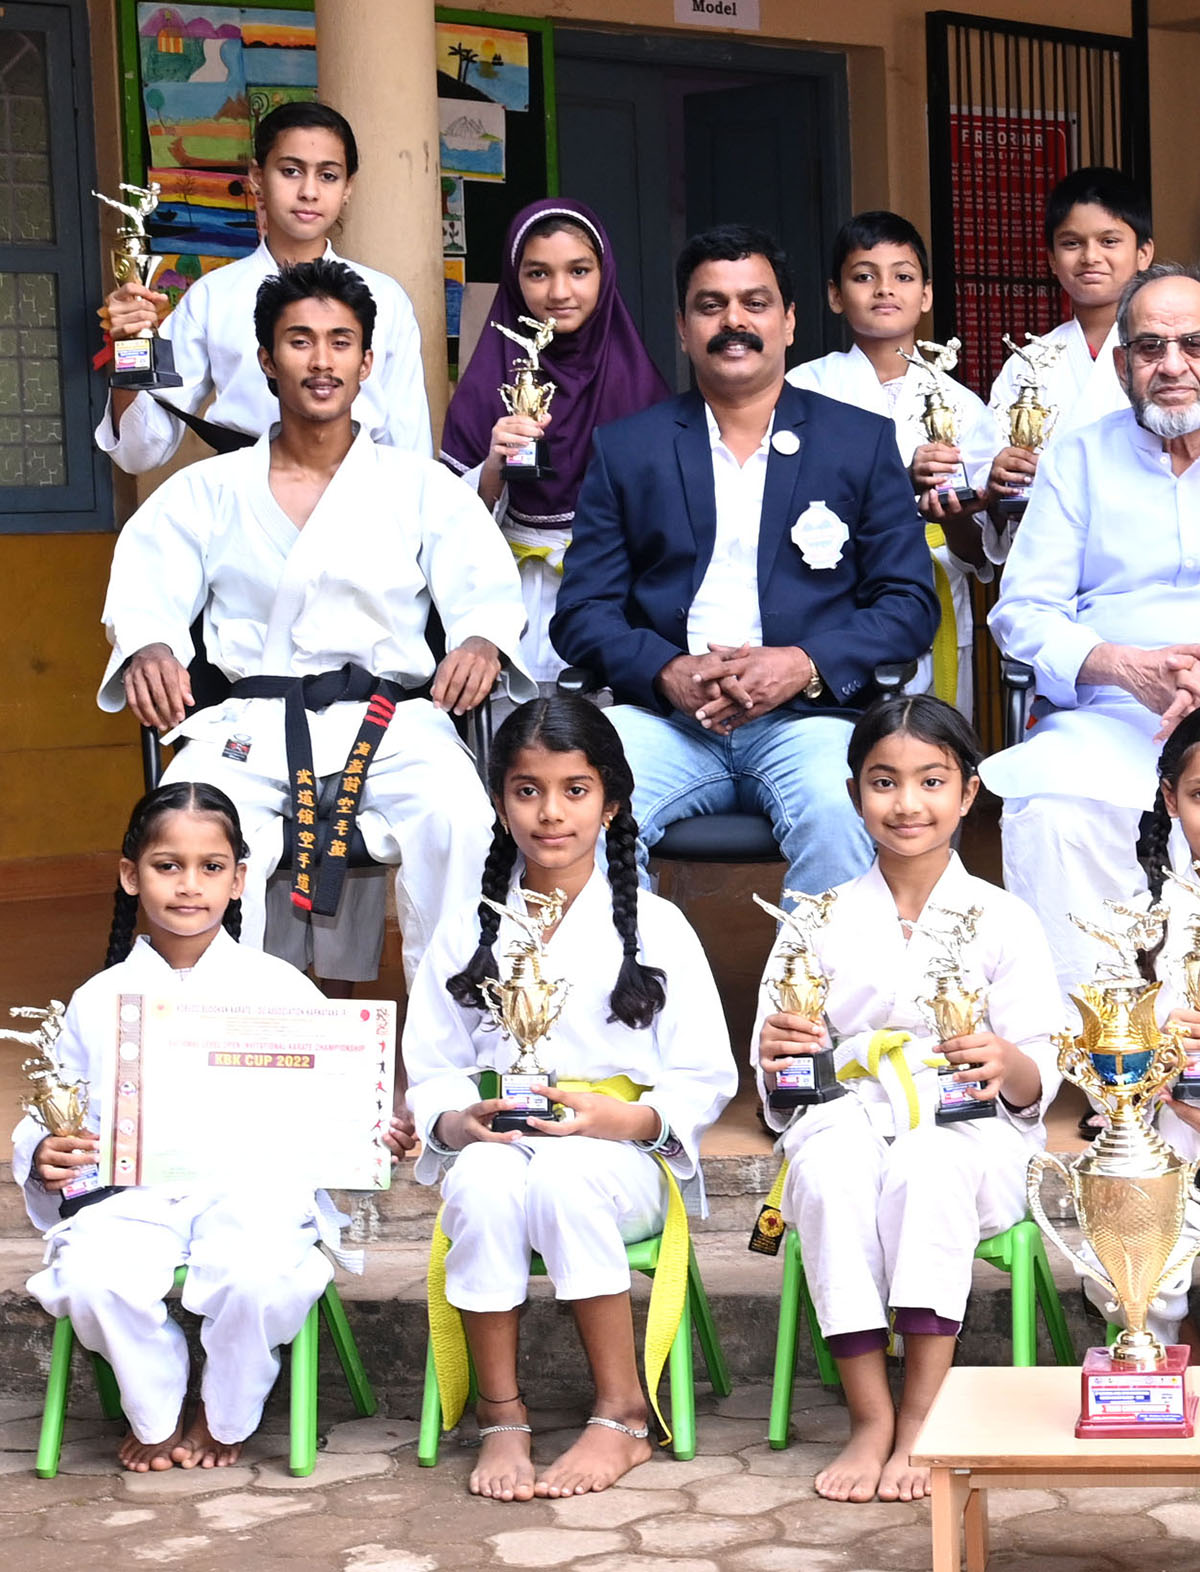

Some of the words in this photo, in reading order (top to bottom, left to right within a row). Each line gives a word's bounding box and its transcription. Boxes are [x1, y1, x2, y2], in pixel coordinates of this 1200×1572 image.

[692, 0, 737, 15] Model
[962, 129, 994, 144] FRE
[215, 1053, 242, 1065] KBK
[245, 1054, 273, 1066] CUP
[276, 1055, 310, 1067] 2022
